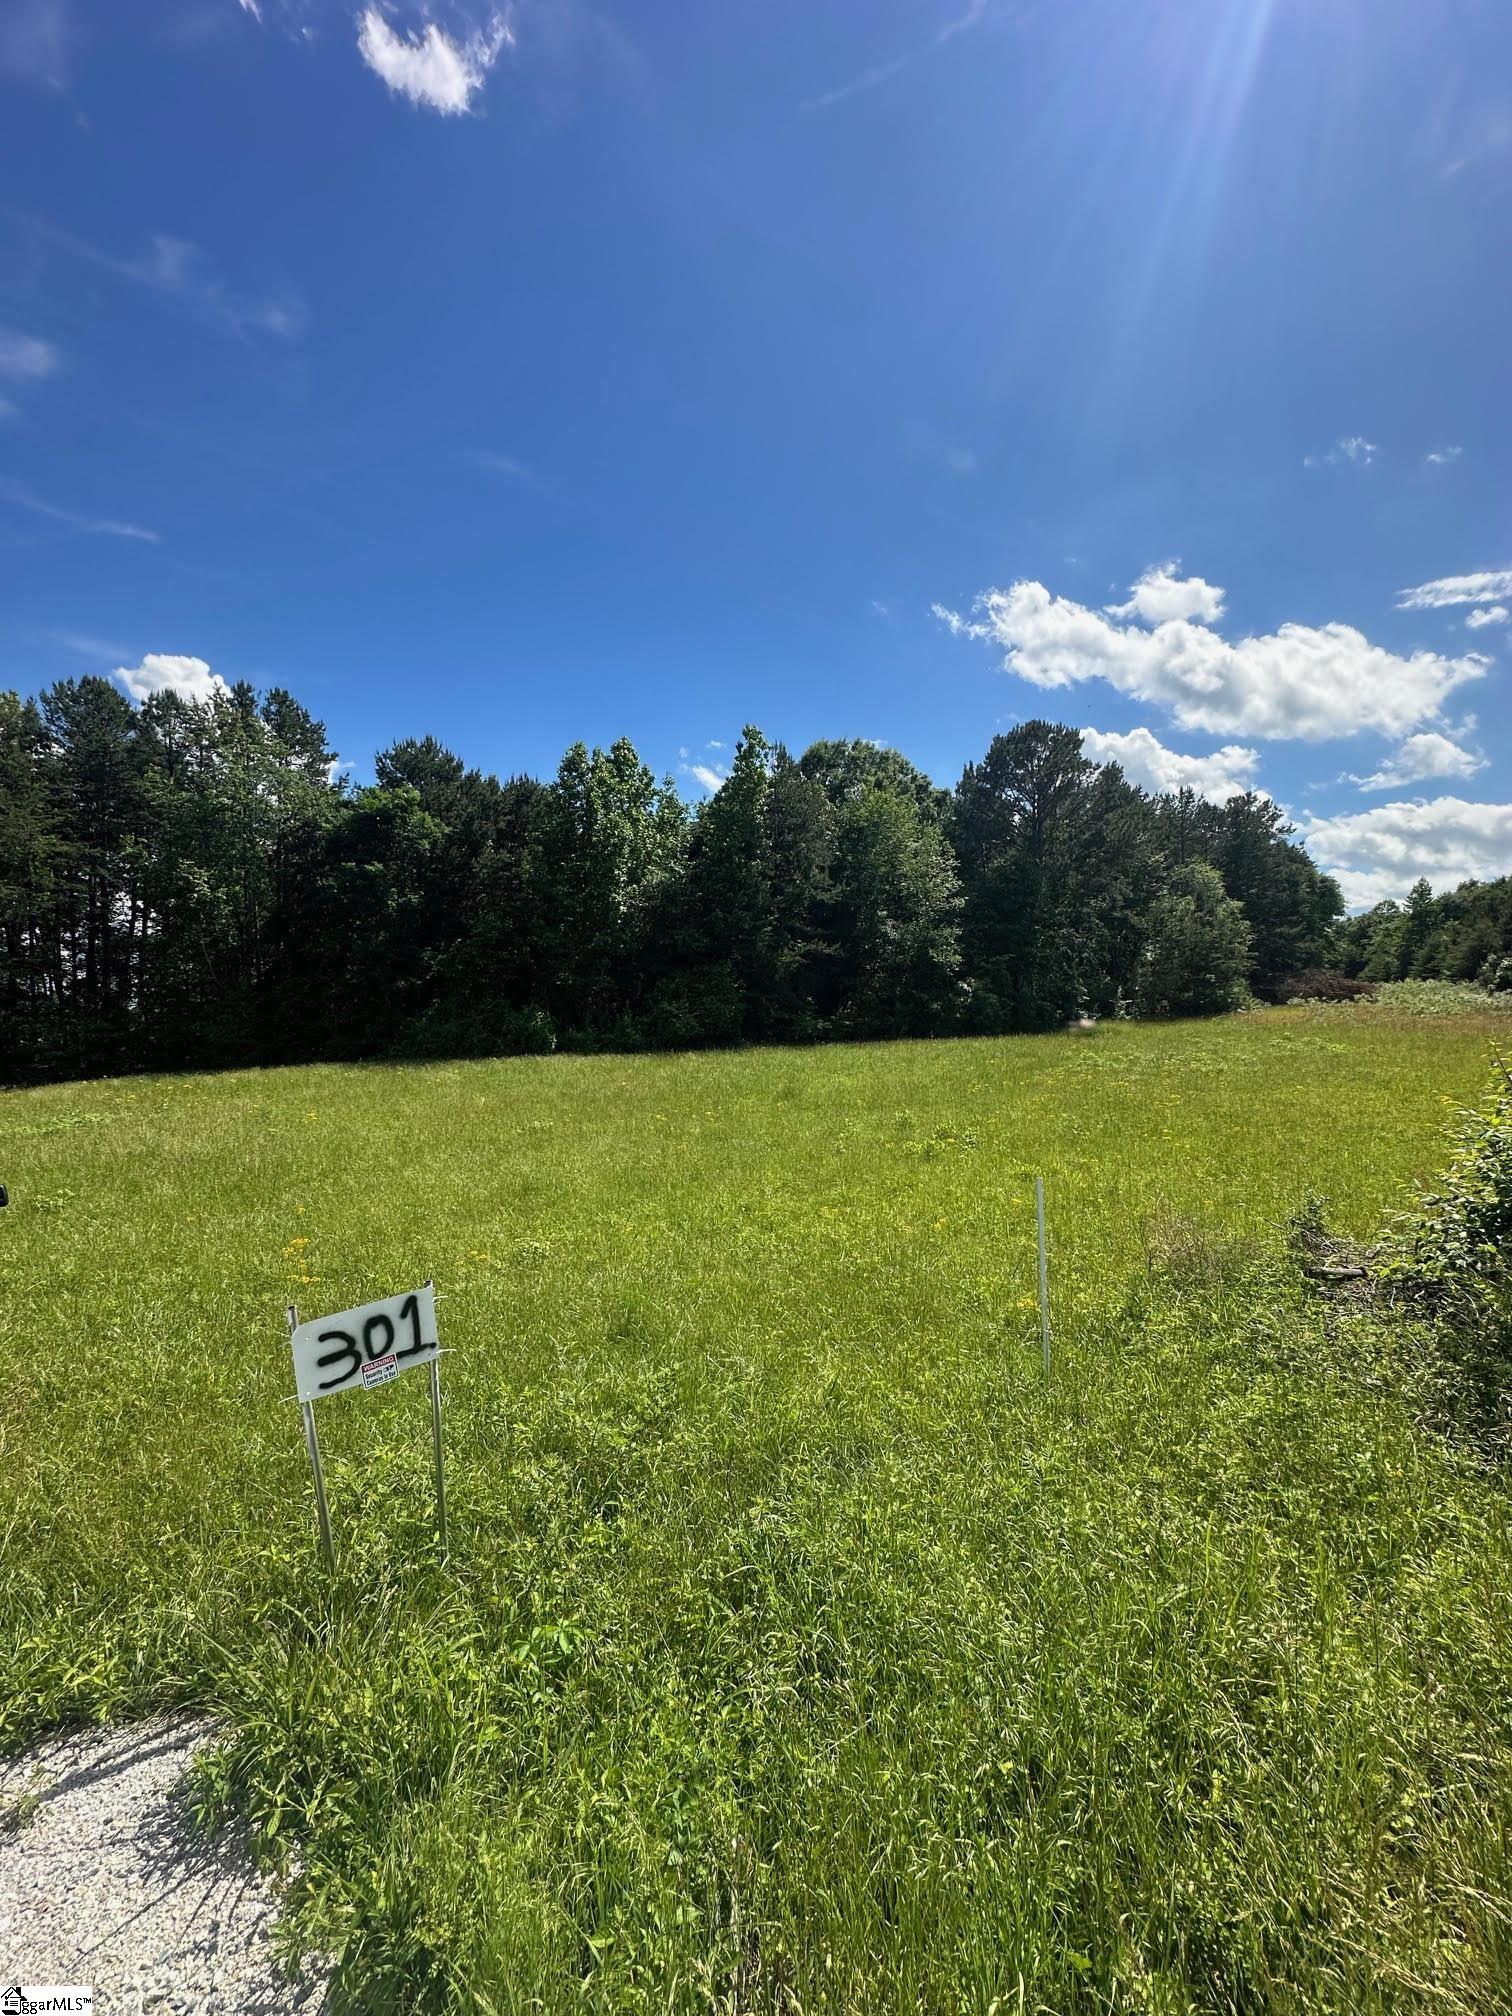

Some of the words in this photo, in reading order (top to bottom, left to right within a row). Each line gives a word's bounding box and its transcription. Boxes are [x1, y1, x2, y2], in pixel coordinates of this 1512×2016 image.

[318, 1295, 436, 1389] 301
[363, 1355, 394, 1371] WARNING
[365, 1370, 382, 1379] Security
[366, 1377, 383, 1385] Cameras
